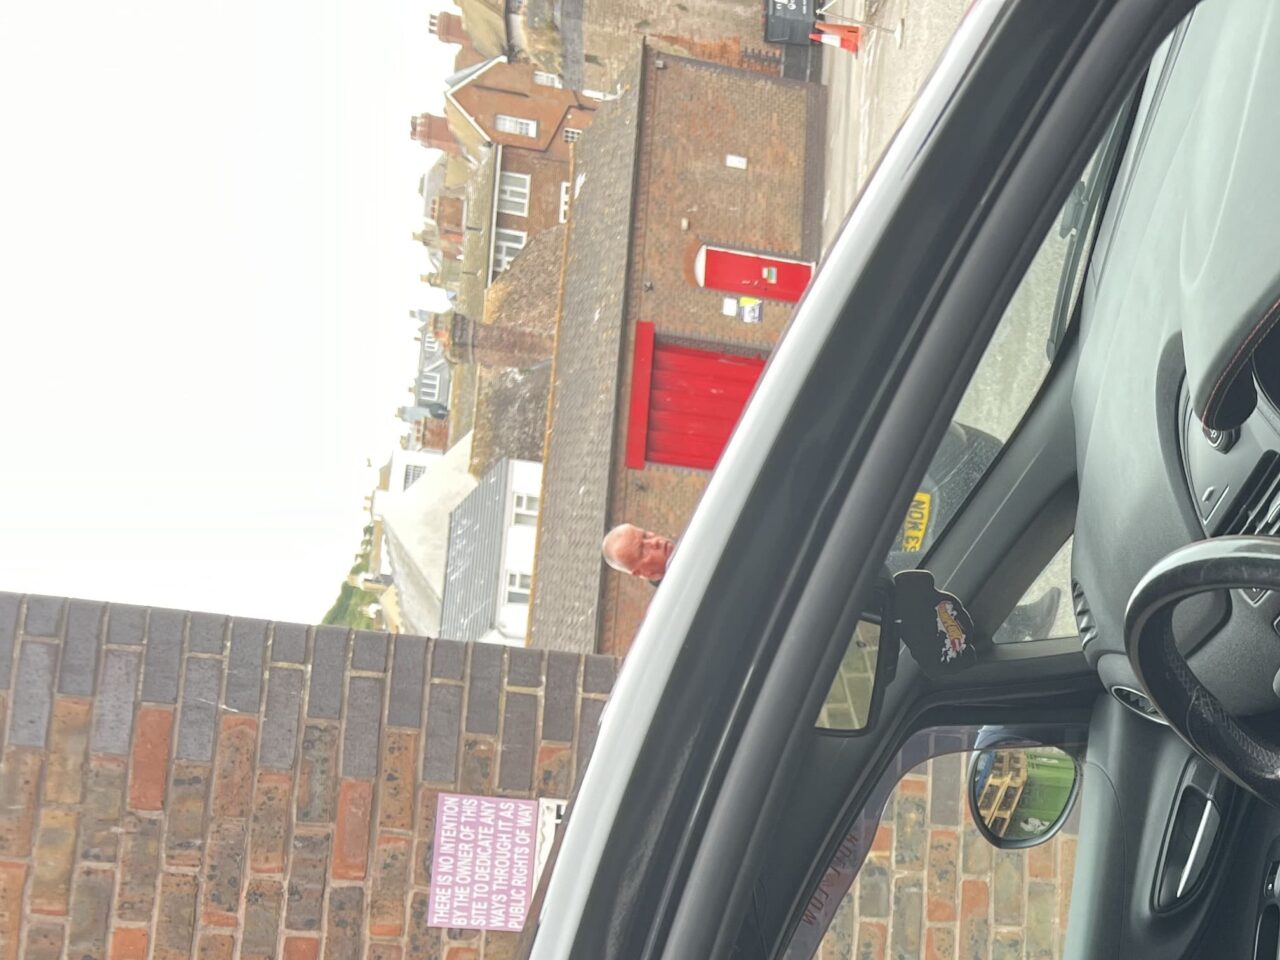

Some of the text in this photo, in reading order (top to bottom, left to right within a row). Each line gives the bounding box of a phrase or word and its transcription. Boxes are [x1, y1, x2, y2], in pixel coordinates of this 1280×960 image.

[433, 796, 460, 924] THERE IS NO INTENTION
[452, 798, 478, 926] BY THE OWNER OF THIS
[470, 800, 496, 926] SITE TO DEDICATE ANY
[489, 802, 515, 927] WAYS THROUGH IT AS
[508, 803, 534, 929] PUBLIC RIGHTS OF WAY
